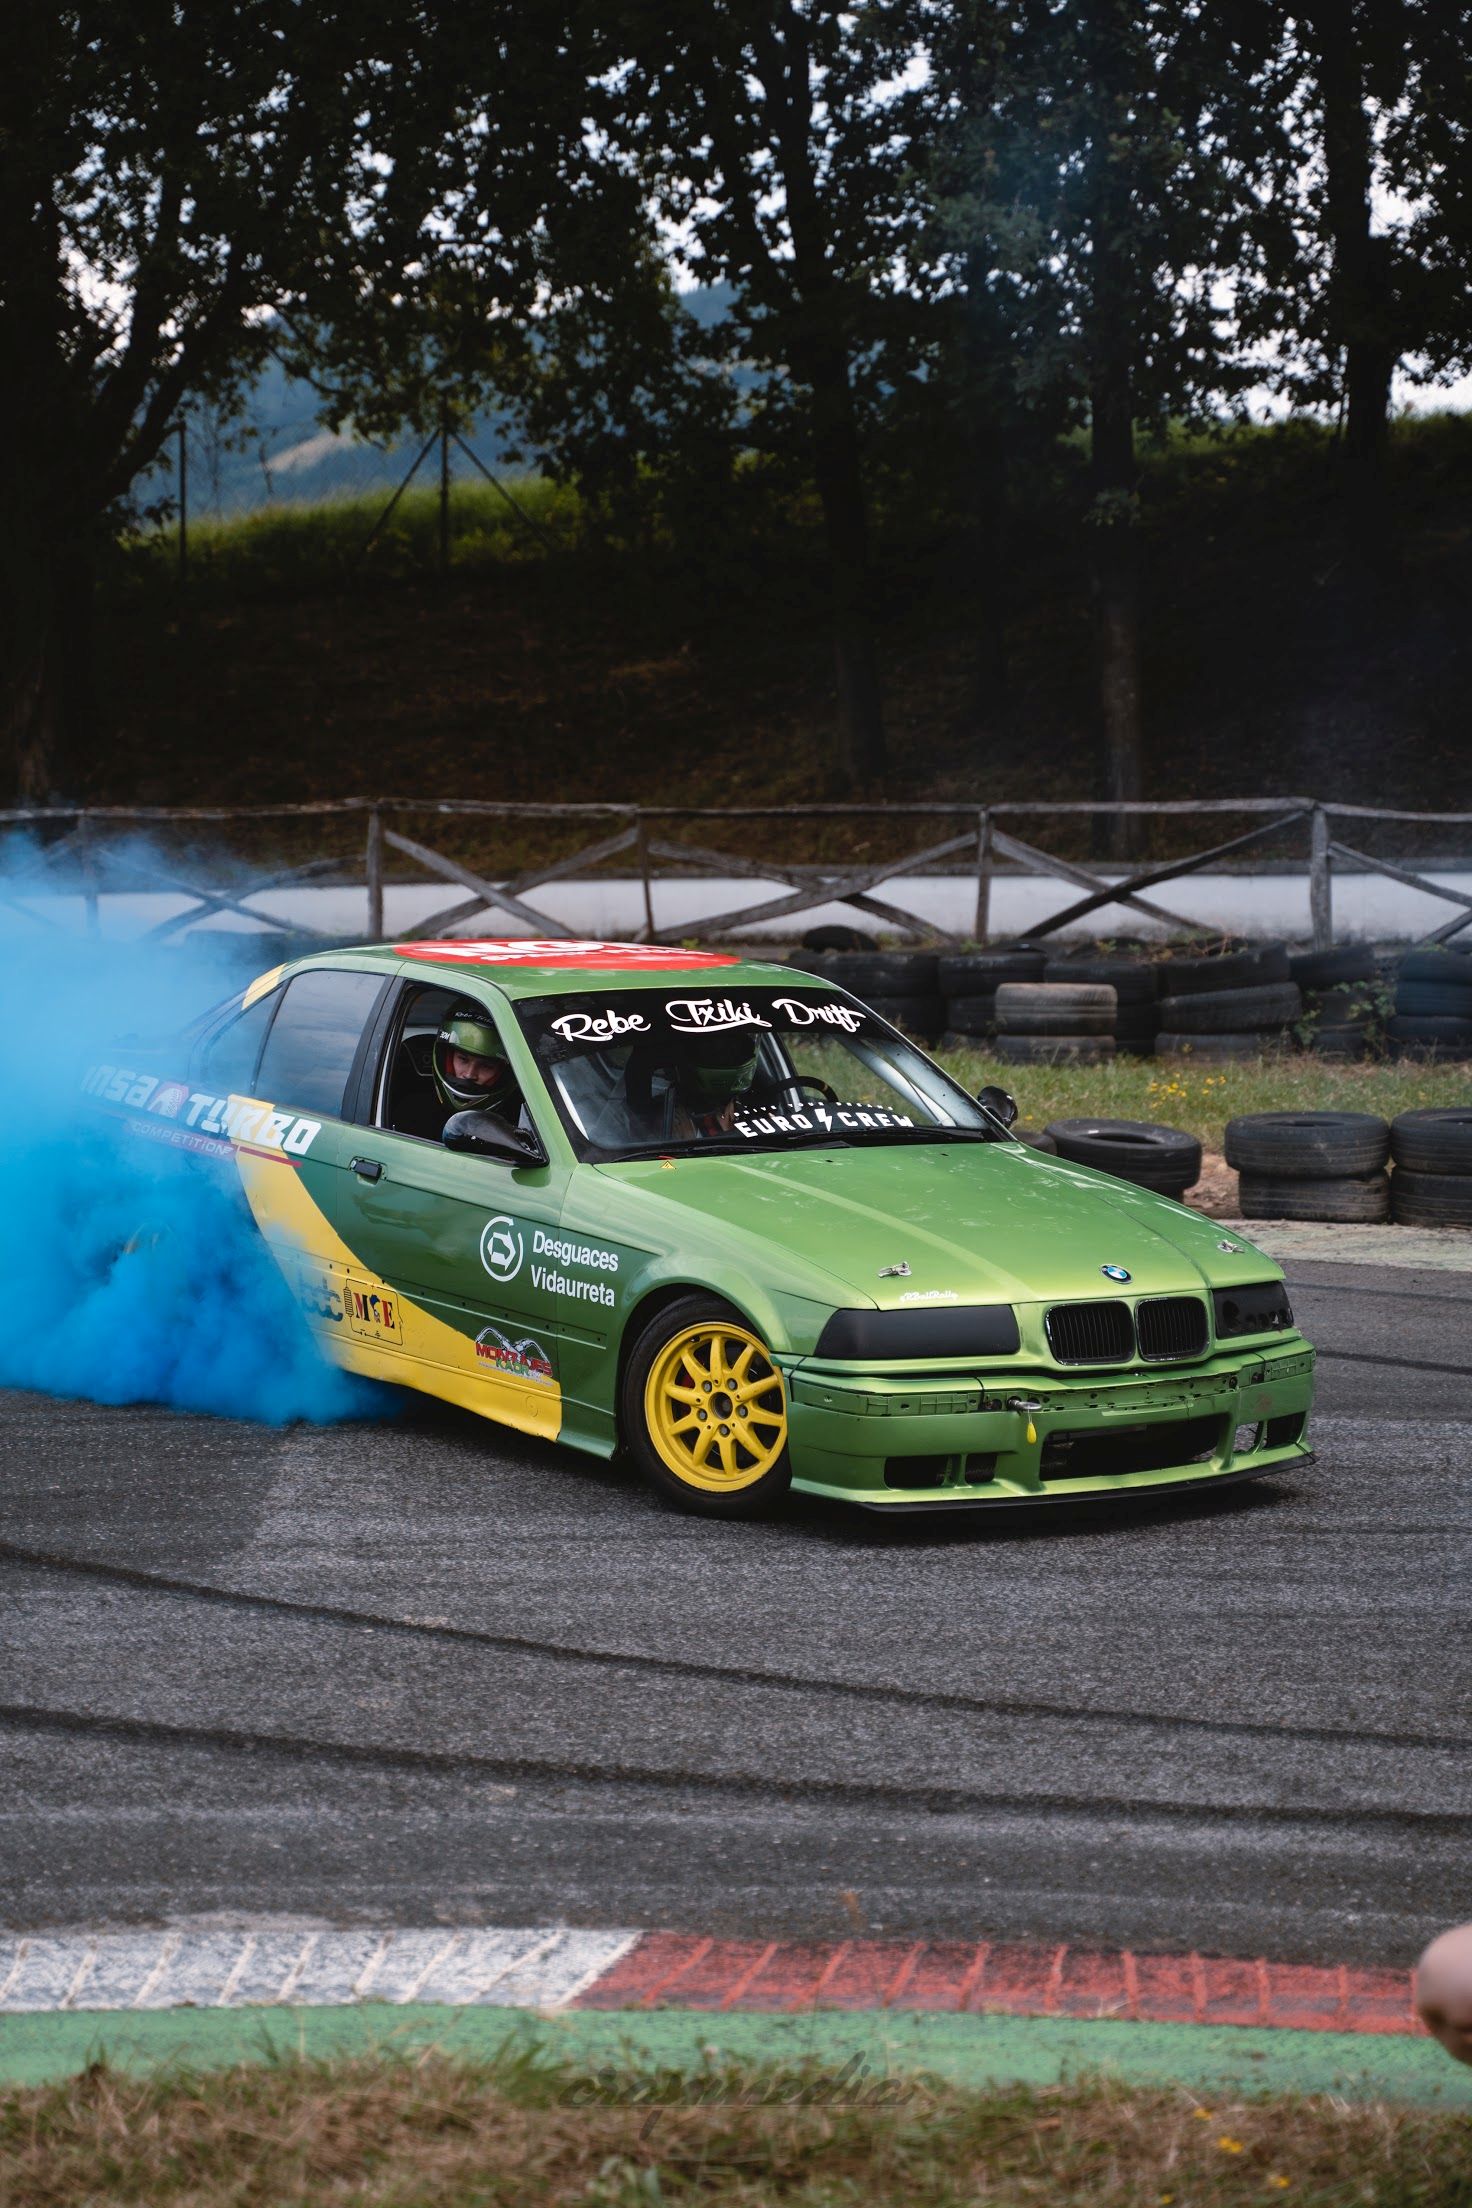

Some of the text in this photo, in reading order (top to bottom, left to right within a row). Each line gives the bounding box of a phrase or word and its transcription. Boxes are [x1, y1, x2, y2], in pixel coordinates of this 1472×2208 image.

[551, 998, 867, 1042] Rebe Txiki Drift
[186, 1093, 322, 1155] TURBO
[733, 1111, 915, 1138] EURO CREW
[532, 1230, 619, 1272] Desguaces
[530, 1264, 615, 1307] Vidaurreta
